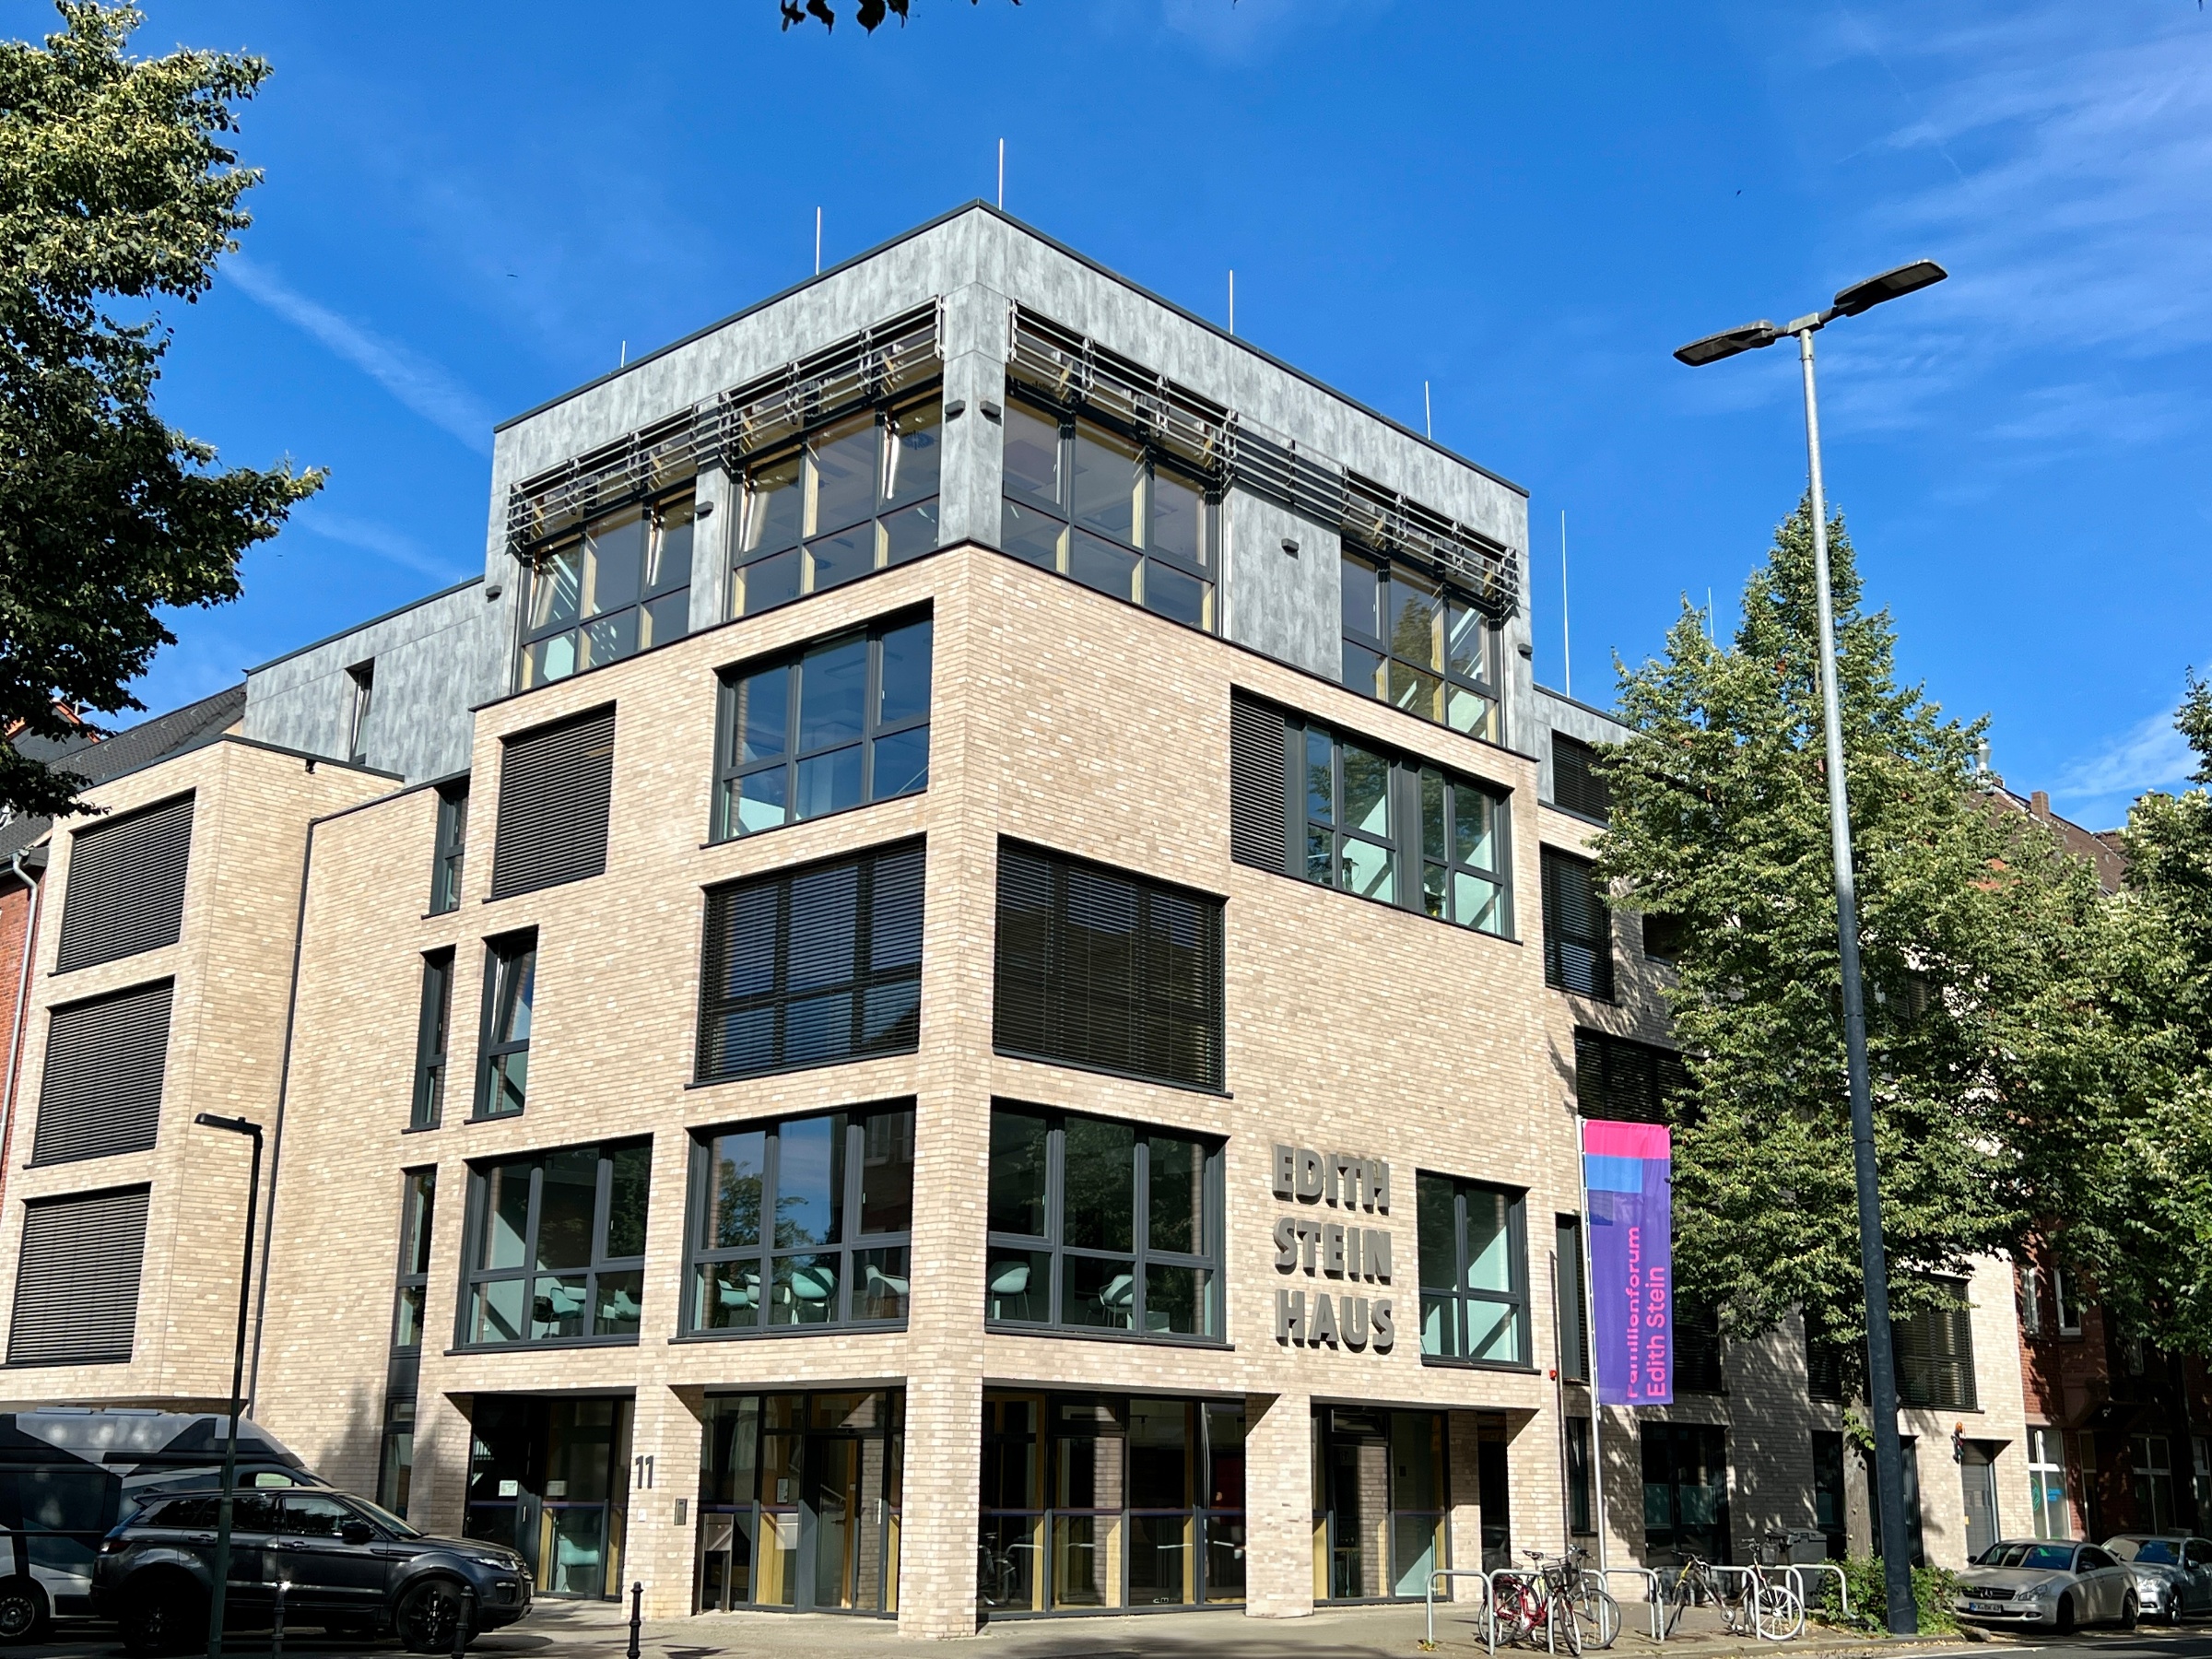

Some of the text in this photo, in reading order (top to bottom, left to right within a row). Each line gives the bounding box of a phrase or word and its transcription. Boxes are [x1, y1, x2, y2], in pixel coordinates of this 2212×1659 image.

[1272, 1144, 1390, 1216] EDITH
[1273, 1217, 1392, 1286] STEIN
[1275, 1288, 1394, 1356] HAUS
[1645, 1266, 1666, 1397] Edith Stein
[635, 1454, 654, 1489] 11
